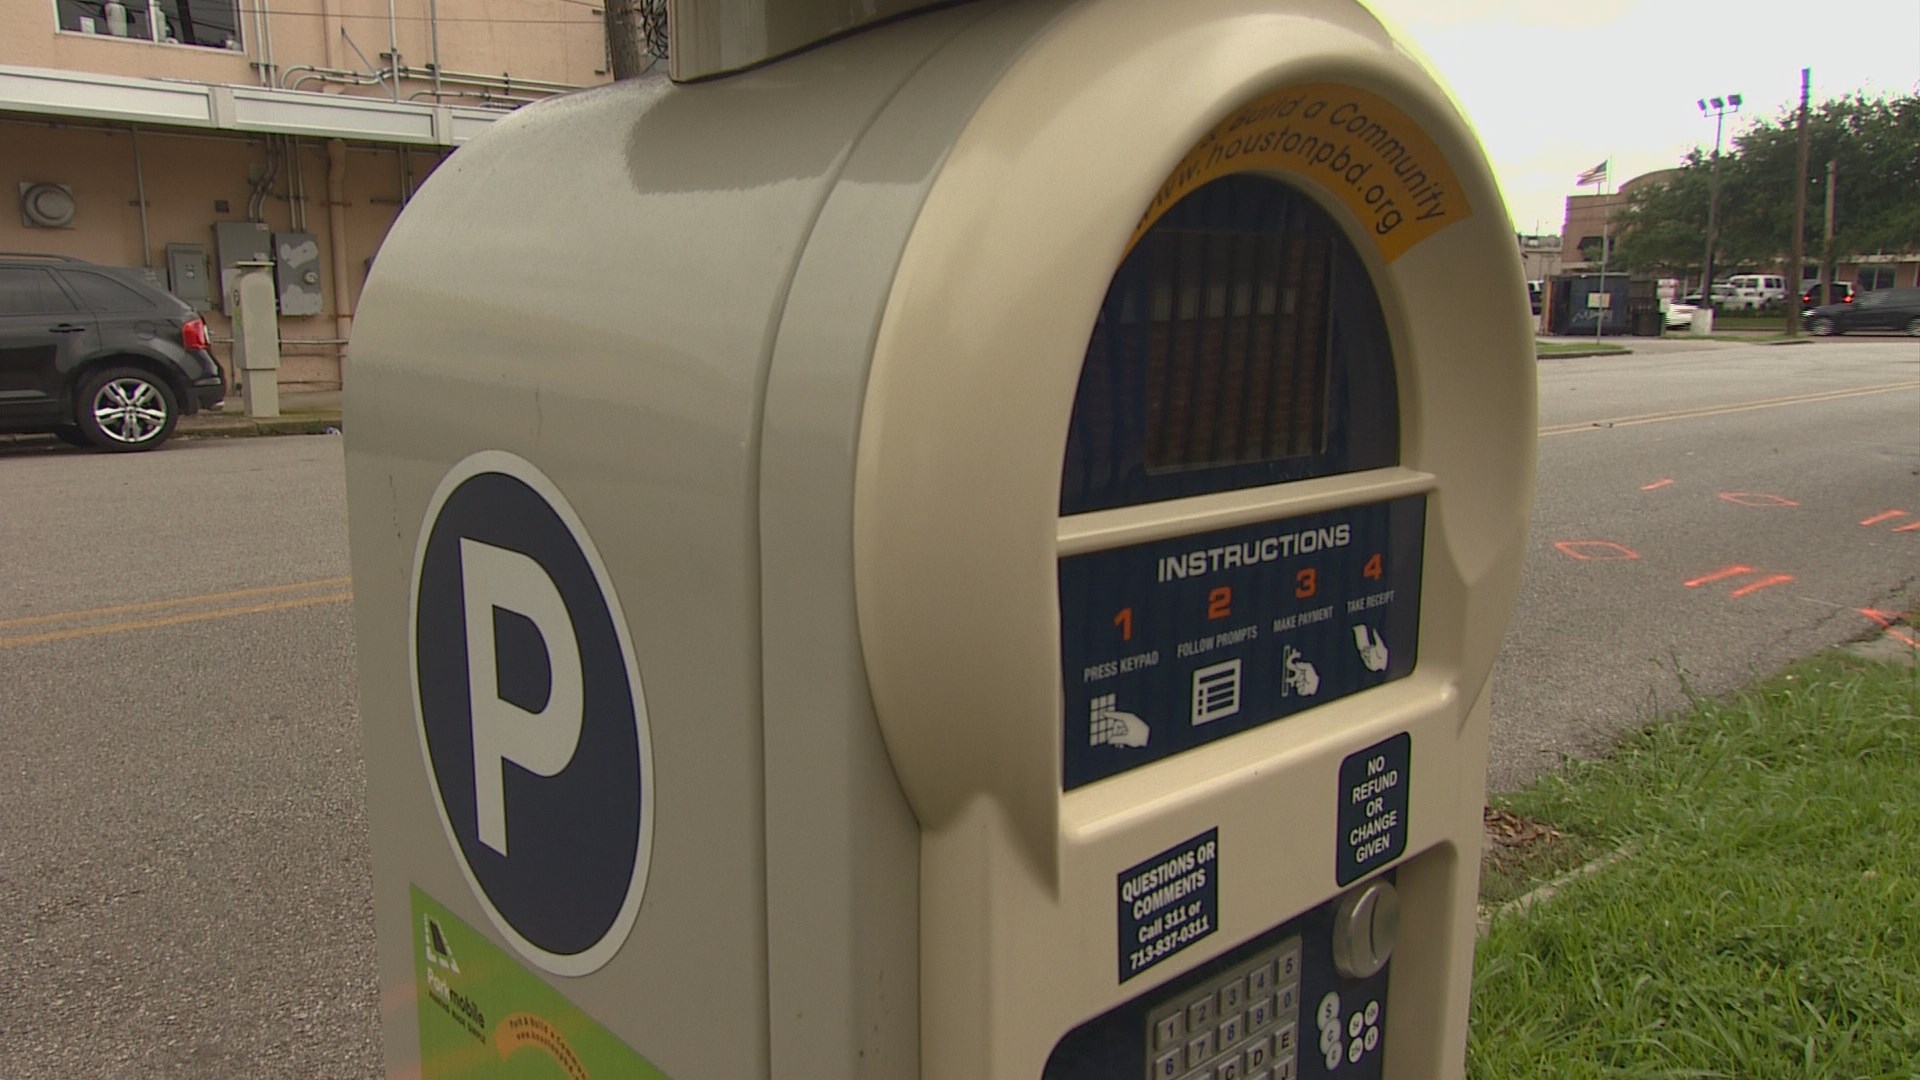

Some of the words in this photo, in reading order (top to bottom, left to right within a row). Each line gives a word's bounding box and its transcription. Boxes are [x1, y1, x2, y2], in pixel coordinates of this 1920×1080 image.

[1304, 101, 1326, 120] a
[1330, 102, 1446, 222] Community
[1158, 524, 1351, 583] INSTRUCTIONS
[1114, 607, 1133, 641] 1
[1207, 586, 1232, 620] 2
[1295, 567, 1317, 599] 3
[1363, 553, 1384, 581] 4
[1346, 599, 1366, 614] TAKE
[1365, 590, 1396, 609] RECEIPT
[1273, 614, 1297, 633] MAKE
[1298, 605, 1334, 626] PAYMENT
[1177, 635, 1215, 659] FOLLOW
[1216, 625, 1259, 648] PROMPTS
[1083, 660, 1119, 683] PRESS
[1119, 650, 1160, 674] KEYPAD
[459, 536, 585, 858] P
[1367, 755, 1386, 777] NO
[1352, 769, 1398, 805] REFUND
[1366, 796, 1384, 818] OR
[1350, 809, 1398, 847] CHANGE
[1356, 832, 1390, 864] GIVEN
[1122, 850, 1195, 903] QUESTIONS
[1197, 841, 1216, 865] OR
[1133, 867, 1207, 921] COMMENTS
[1138, 917, 1163, 943] Call
[1164, 905, 1187, 931] 311
[1188, 900, 1202, 918] or
[1129, 914, 1211, 971] 713-837-0311
[1167, 1022, 1175, 1039] 1
[1198, 1005, 1207, 1020] 2
[1228, 988, 1237, 1003] 3
[1257, 973, 1265, 988] 4
[1285, 957, 1294, 974] 5
[1165, 1057, 1174, 1076] 6
[1197, 1040, 1206, 1060] 7
[1227, 1023, 1236, 1041] 8
[1256, 1007, 1265, 1024] 9
[1253, 1049, 1265, 1067] D
[1281, 1030, 1291, 1050] E
